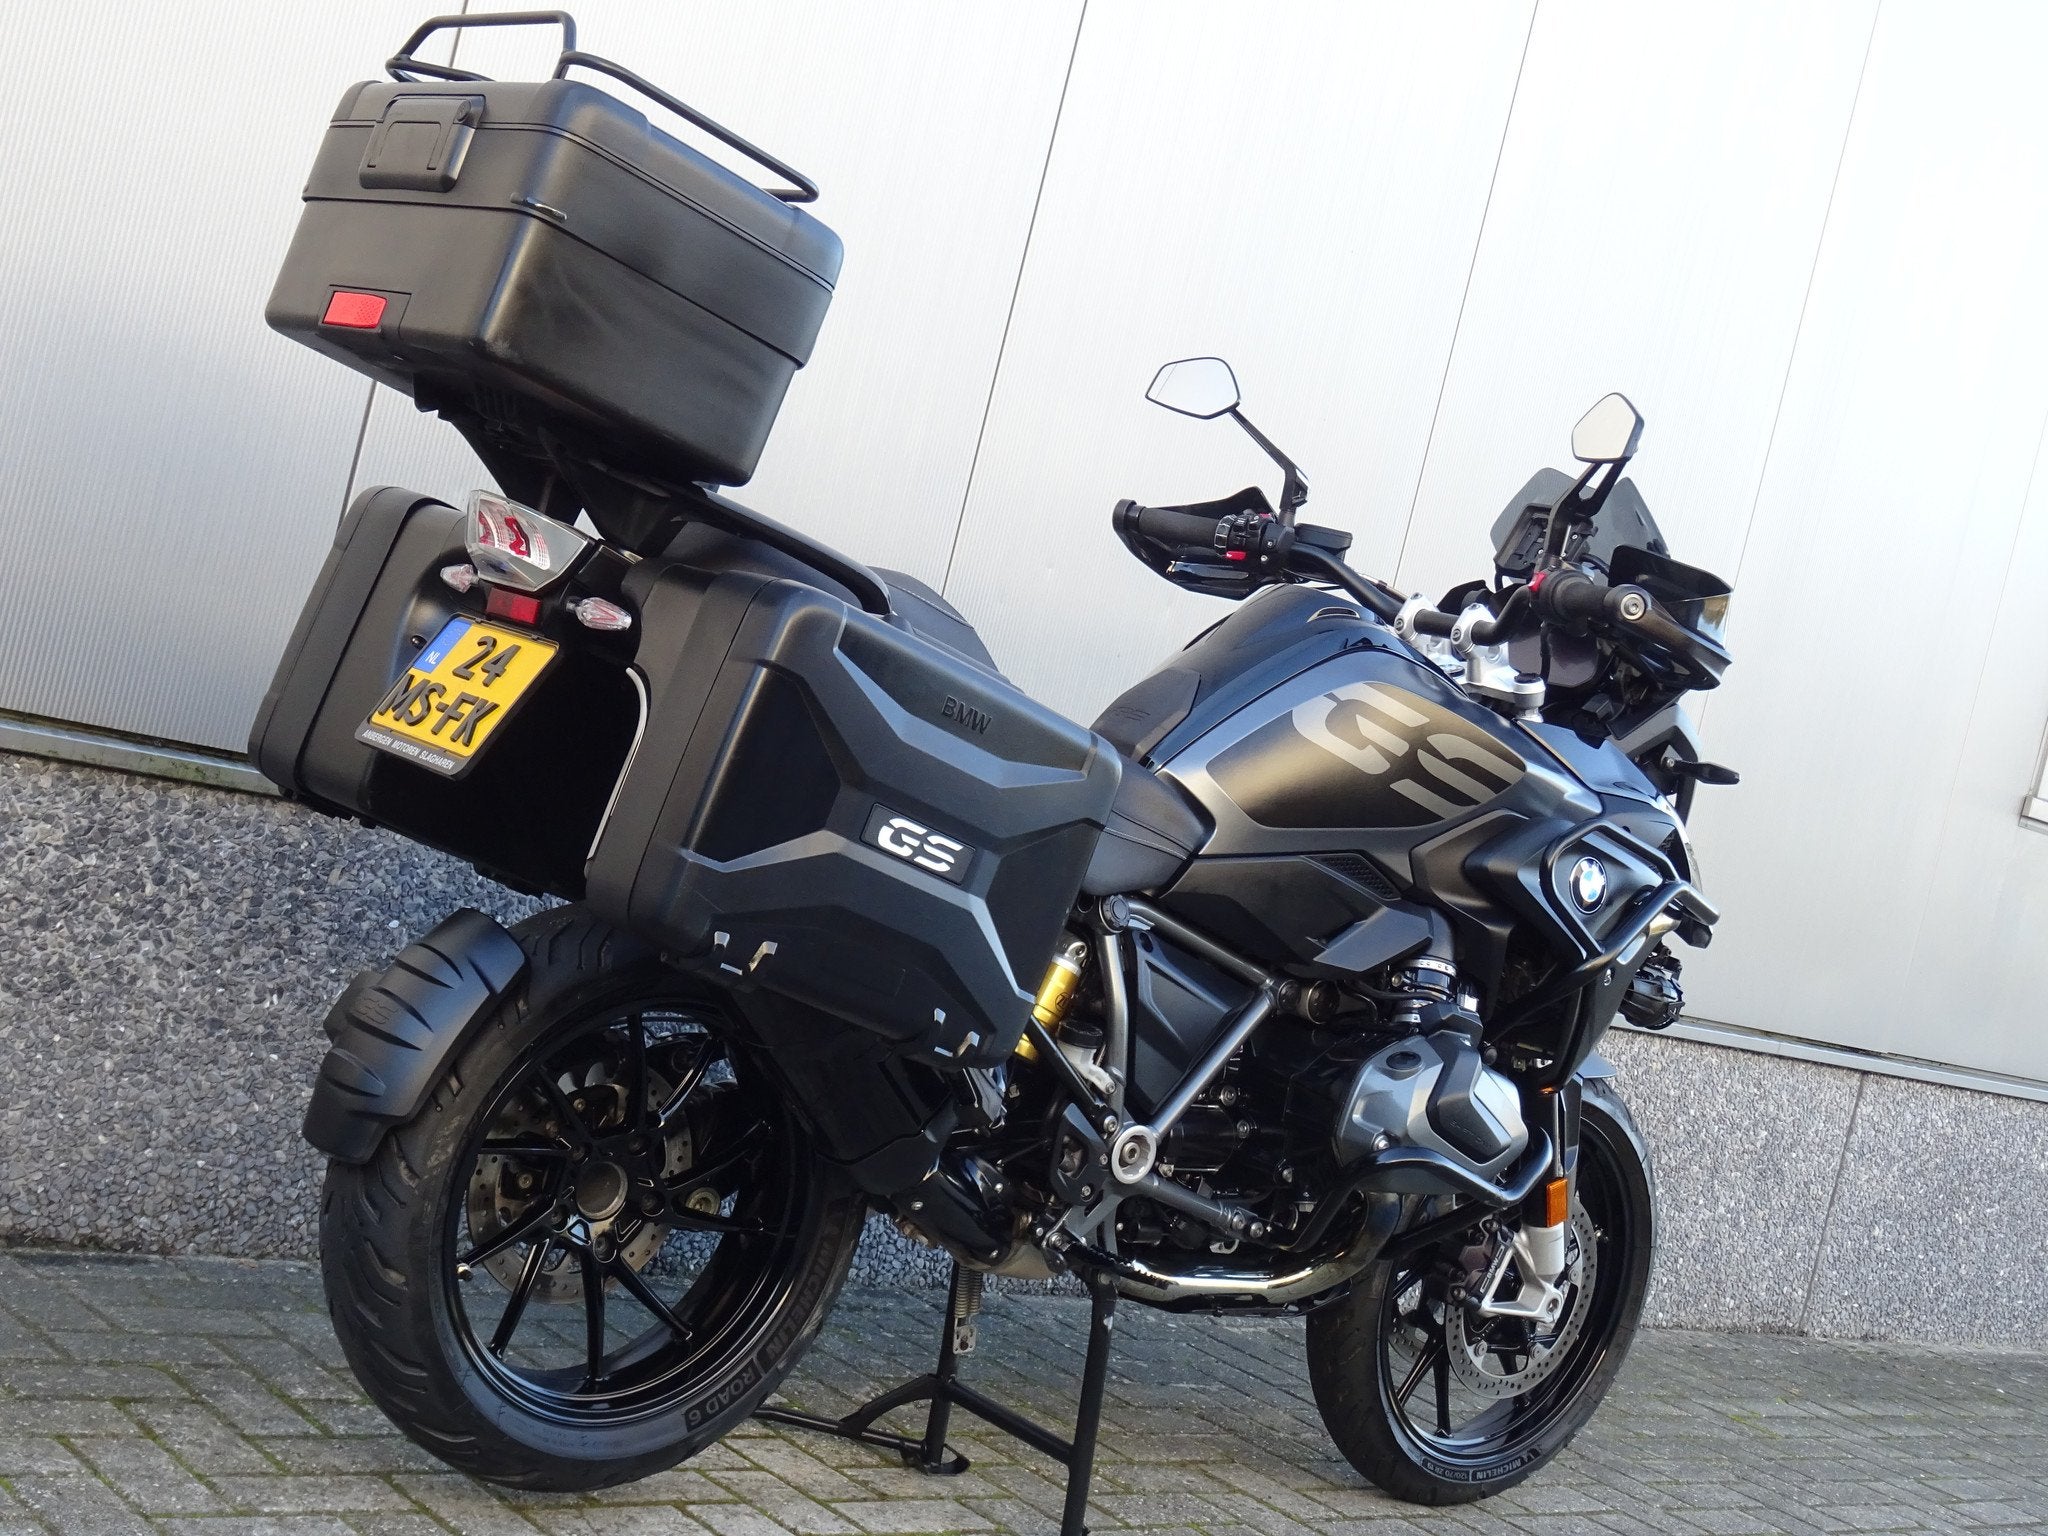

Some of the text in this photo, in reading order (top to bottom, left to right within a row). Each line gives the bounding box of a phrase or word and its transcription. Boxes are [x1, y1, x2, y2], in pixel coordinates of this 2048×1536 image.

[425, 652, 441, 665] NL
[452, 635, 522, 687] 24
[377, 673, 500, 747] MS-FK
[941, 694, 992, 735] BMW
[391, 738, 421, 758] MOTOREN
[420, 748, 456, 770] SLAGHAREN
[1292, 680, 1526, 820] GS
[877, 817, 965, 872] GS
[690, 1362, 757, 1426] ROAD 6
[1476, 1459, 1522, 1480] MICHELIN
